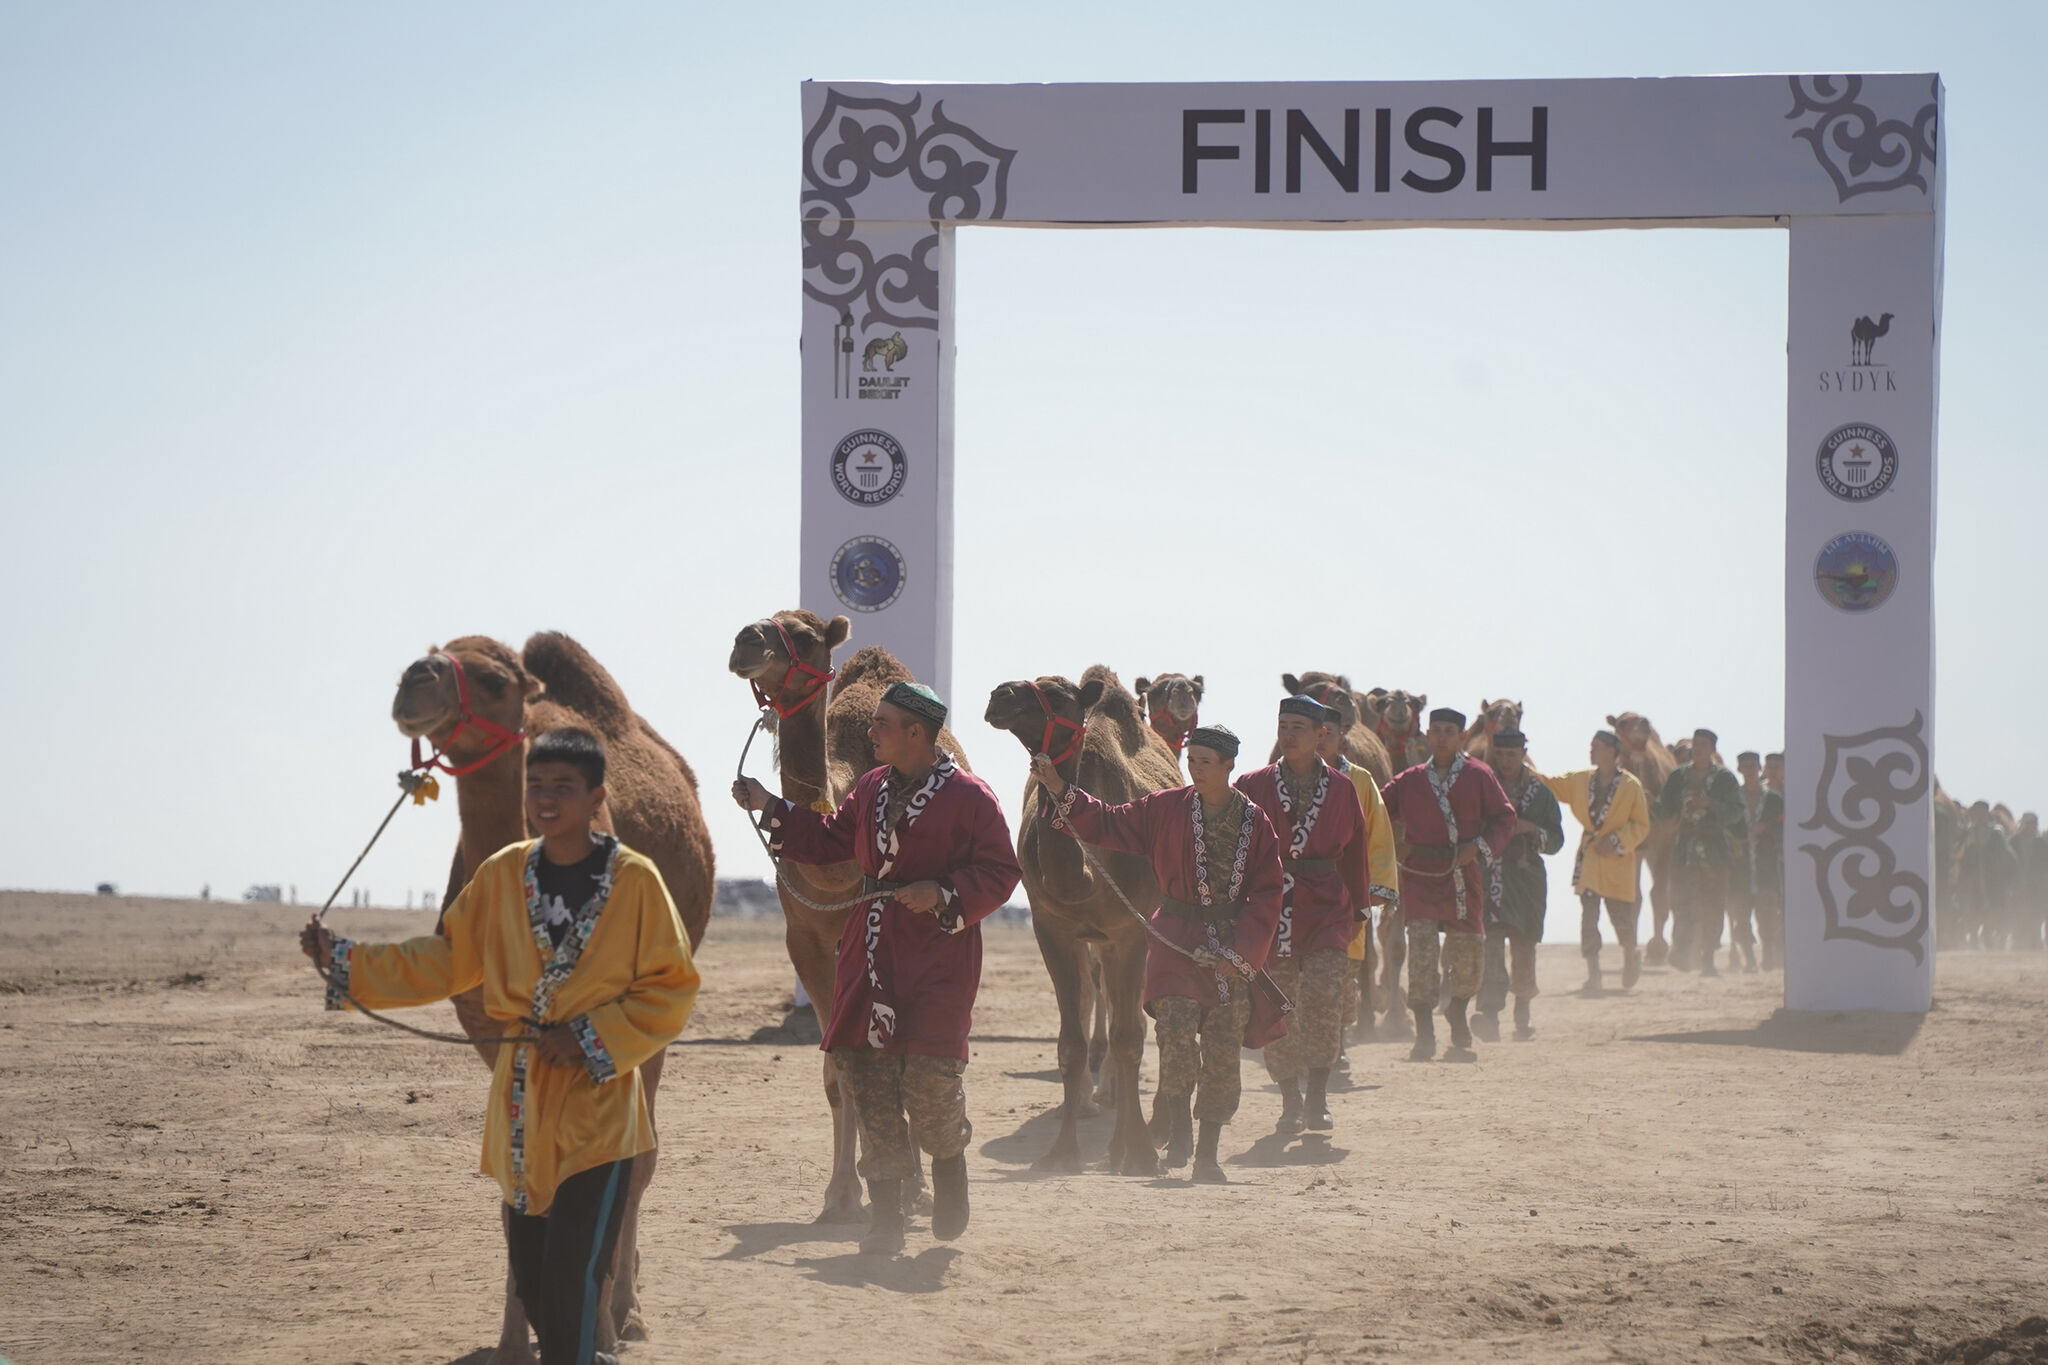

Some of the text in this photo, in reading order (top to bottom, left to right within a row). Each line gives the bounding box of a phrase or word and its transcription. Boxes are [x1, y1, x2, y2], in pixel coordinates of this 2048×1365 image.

[1182, 106, 1548, 193] FINISH
[858, 377, 910, 387] DAULET
[1819, 371, 1897, 392] SYDYK
[840, 433, 899, 455] GUINNESS
[1828, 427, 1888, 449] GUINNESS
[834, 462, 904, 503] WORLD RECORDS
[1821, 457, 1894, 498] WORLD RECORDS
